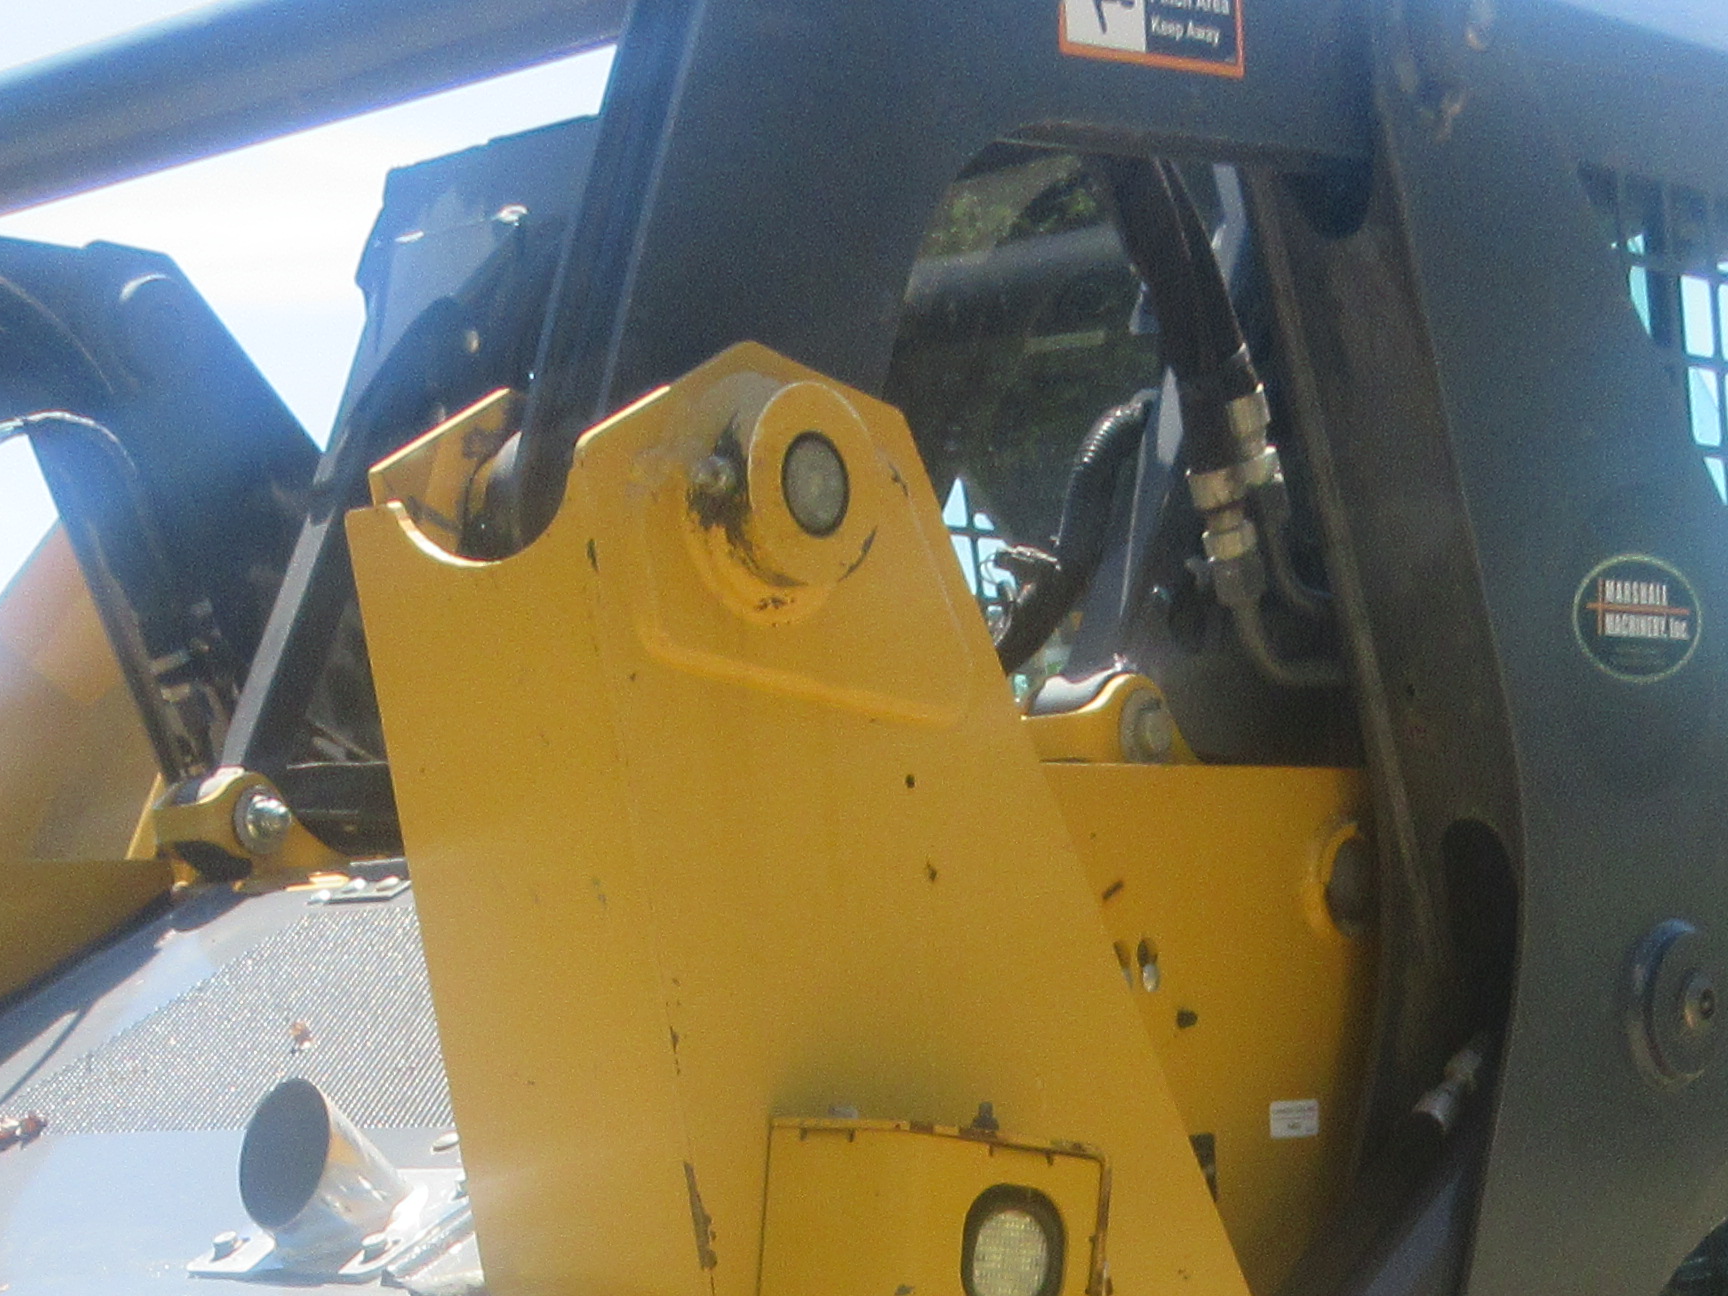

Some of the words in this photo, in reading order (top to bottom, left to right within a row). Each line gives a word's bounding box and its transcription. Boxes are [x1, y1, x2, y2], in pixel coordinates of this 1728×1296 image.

[1151, 14, 1184, 41] Keep
[1186, 20, 1221, 48] Away
[1604, 579, 1668, 606] MARSHALL
